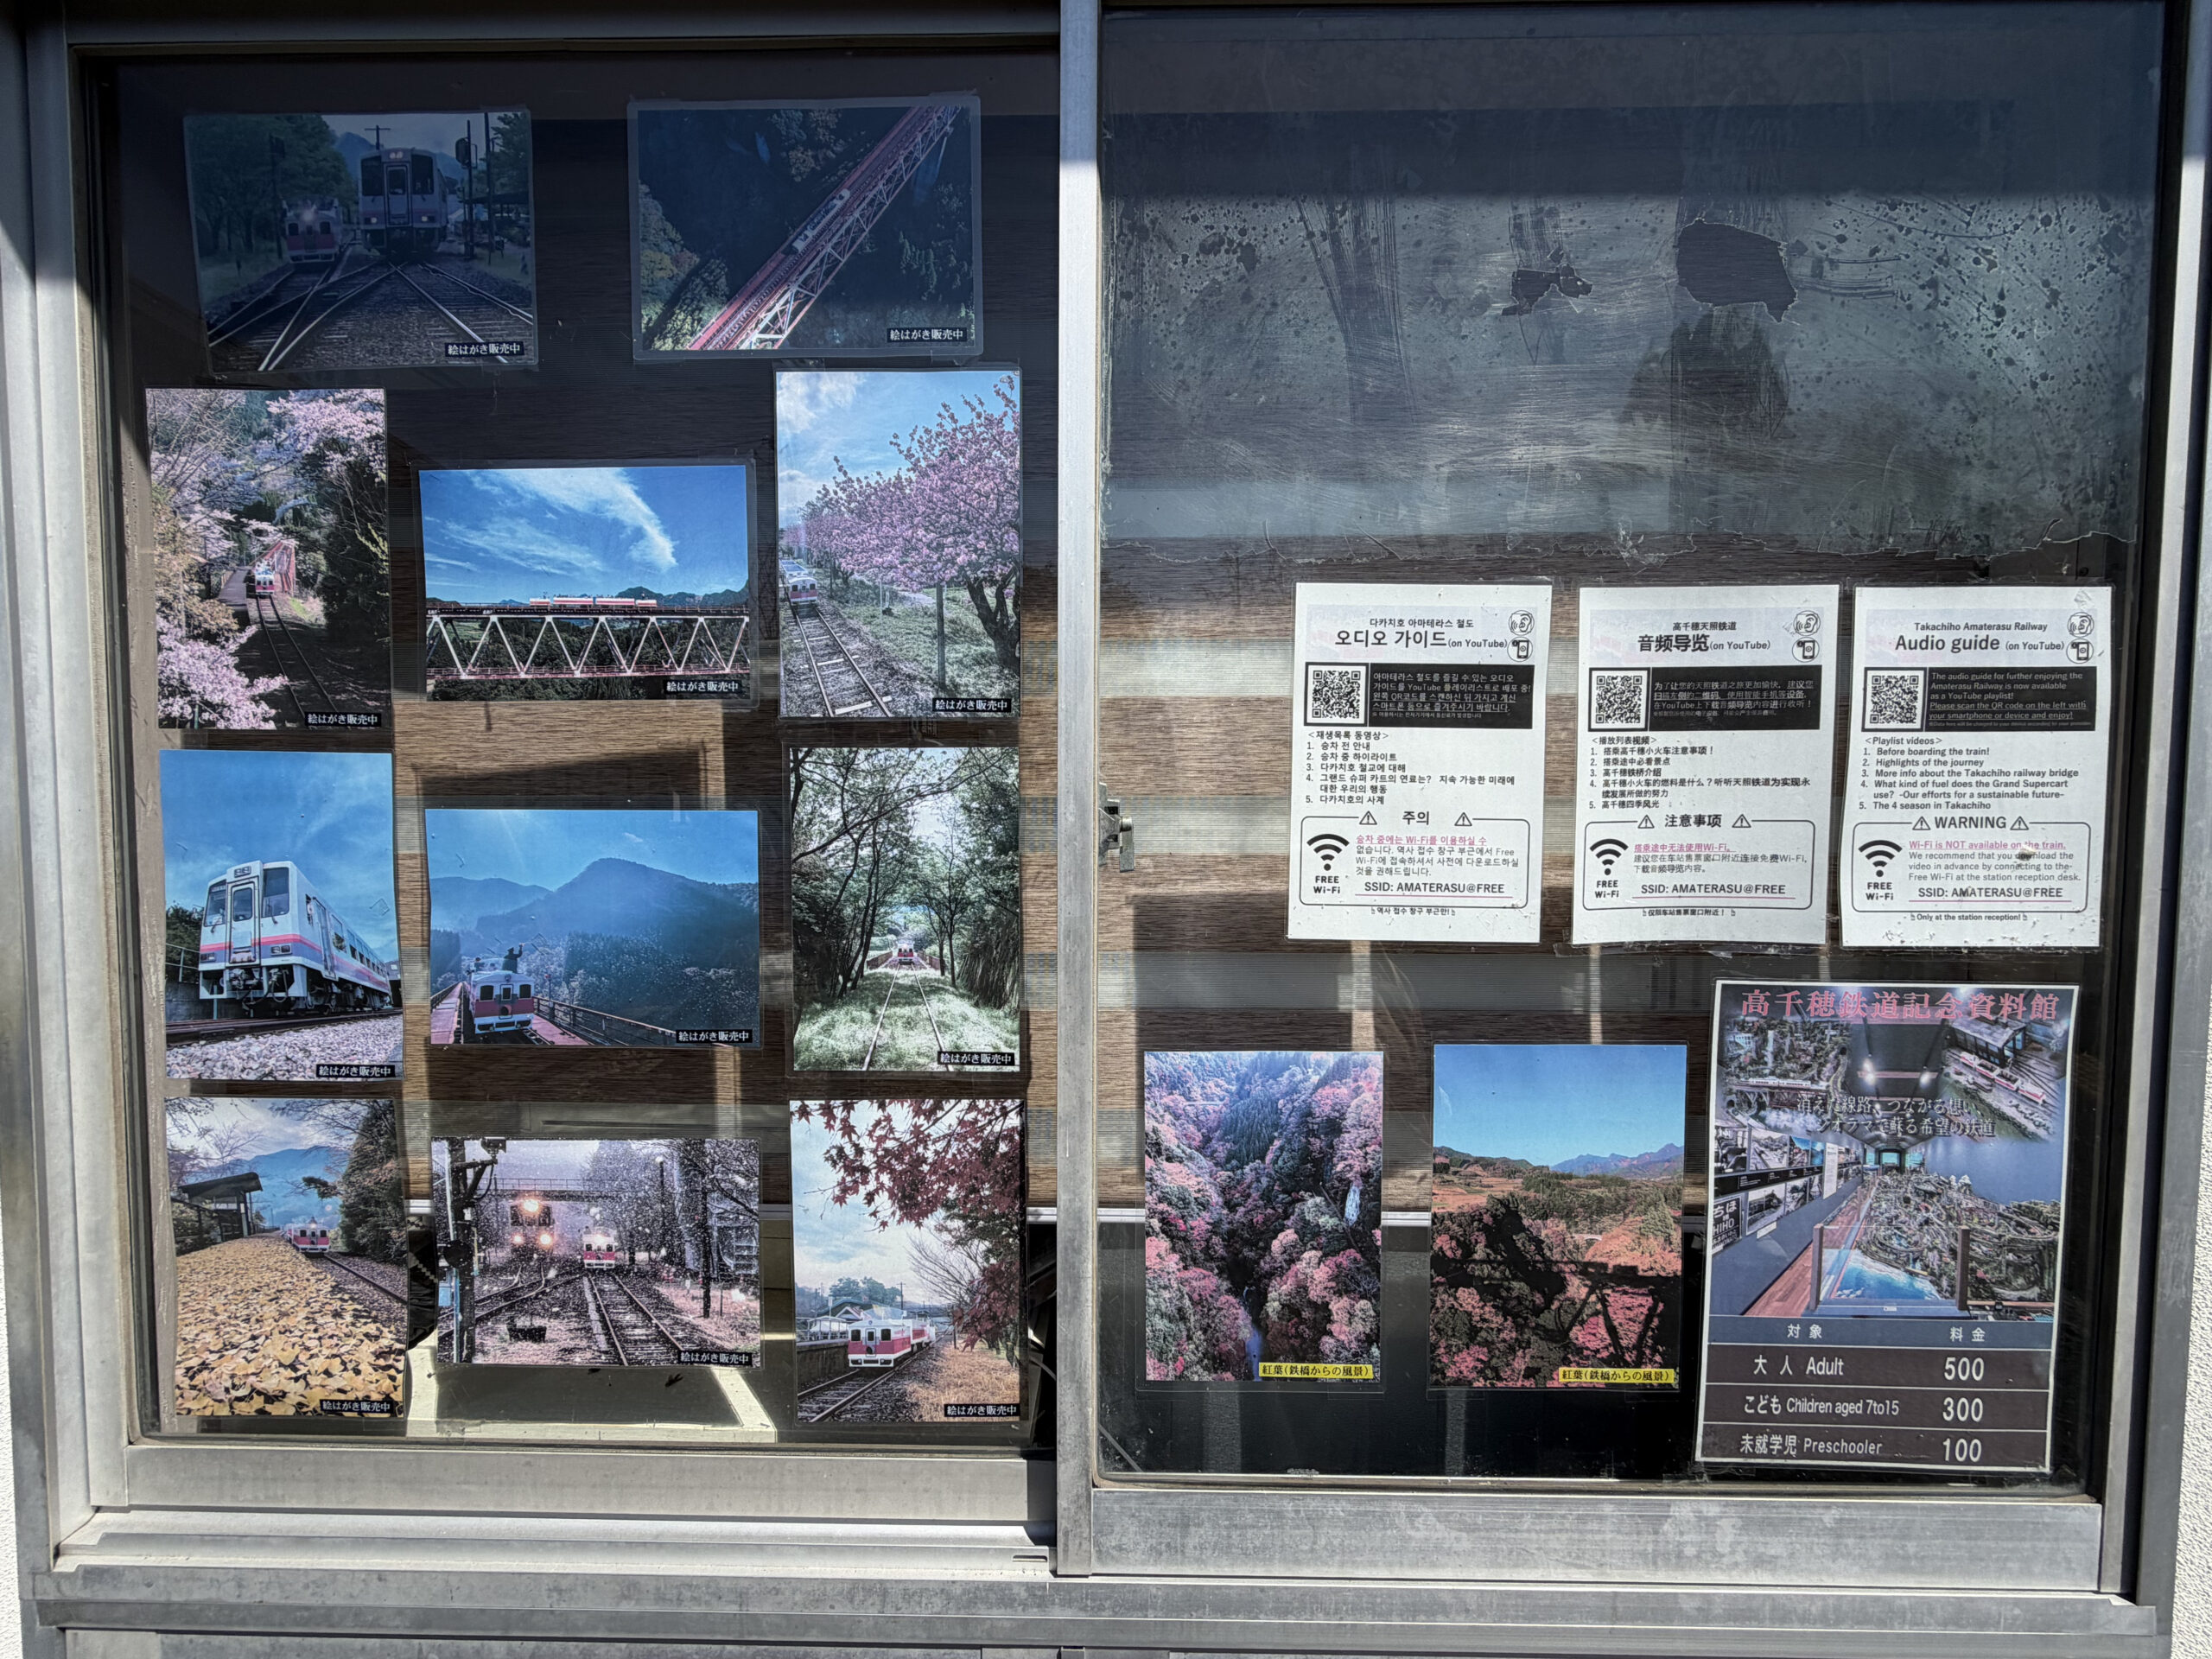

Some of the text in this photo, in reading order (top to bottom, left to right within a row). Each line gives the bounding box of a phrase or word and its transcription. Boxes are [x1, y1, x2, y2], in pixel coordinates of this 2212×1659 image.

[890, 328, 963, 340] 絵はがき販売中
[448, 342, 520, 357] 絵はがき販売中
[1370, 618, 1474, 628] 다카치호 아마테라스 철도
[1914, 621, 2048, 632] Takachiho Amaterasu Railway
[1335, 629, 1388, 648] 오디오
[1395, 630, 1447, 648] 가이드
[1465, 639, 1509, 649] YouTube)
[1637, 633, 1710, 652] 音频导览
[1726, 639, 1770, 650] YouTube)
[1895, 634, 2065, 654] Audio guide (on YouTube)
[1970, 672, 1993, 681] guide
[2034, 671, 2068, 681] enjoying
[666, 681, 739, 692] 絵はがき販売中
[935, 699, 1007, 710] 絵はがき販売中
[308, 714, 378, 725] 絵はがき販売中
[1591, 747, 1598, 756] 1.
[1863, 747, 1990, 757] 1. Before boarding the train!
[1306, 762, 1406, 772] 3. 다카치호 철교에 대해
[1590, 758, 1598, 766] 2.
[1862, 758, 1984, 768] 2. Highlights of the journey
[1590, 768, 1597, 777] 3.
[1861, 768, 2079, 779] 3. More info about the Takachiho railway bridge
[1306, 773, 1515, 785] 4. 그랜드 슈퍼 카트의 연료는? 지속 가능한 미래에
[1589, 779, 1597, 788] 4.
[1860, 779, 2069, 789] 4. What kind of fuel does the Grand Supercart
[1319, 784, 1388, 794] 대한 우리의 행동
[1873, 790, 1895, 799] use?
[1921, 790, 1951, 799] efforts
[1954, 790, 1967, 799] for
[1306, 794, 1384, 805] 5. 다카치호의 사계
[1589, 800, 1596, 810] 5.
[1859, 801, 1866, 810] 5.
[1872, 801, 1890, 810] The
[1891, 801, 1897, 810] 4
[1934, 801, 1942, 810] in
[1944, 801, 1991, 810] Takachiho
[1402, 810, 1429, 825] 주의
[1665, 814, 1722, 828] 注意事项
[1935, 816, 2006, 829] WARNING
[1315, 875, 1339, 884] FREE
[1596, 880, 1618, 888] FREE
[1313, 886, 1340, 894] Wi-Fi
[1364, 881, 1504, 893] SSID: AMATERASU@FREE
[1641, 884, 1786, 894] SSID: AMATERASU@FREE
[1918, 886, 2063, 898] SSID: AMATERASU@FREE
[1594, 890, 1619, 899] Wi-Fi
[1740, 988, 2061, 1021] 高千穂鉄道記念資料館
[678, 1031, 749, 1041] 絵はがき販売中
[940, 1052, 1013, 1065] 絵はがき販売中
[319, 1065, 391, 1077] 絵はがき販売中
[679, 1351, 750, 1365] 絵はがき販売中
[1806, 1357, 1844, 1376] Adult
[1944, 1357, 1984, 1381] 500
[321, 1399, 391, 1413] 絵はがき販売中
[947, 1405, 1016, 1415] 絵はがき販売中
[1745, 1395, 1782, 1414] こども
[1786, 1397, 1833, 1414] Children
[1834, 1399, 1863, 1417] aged
[1942, 1397, 1983, 1422] 300
[1740, 1433, 1981, 1462] 未就学児 Preschooler 100
